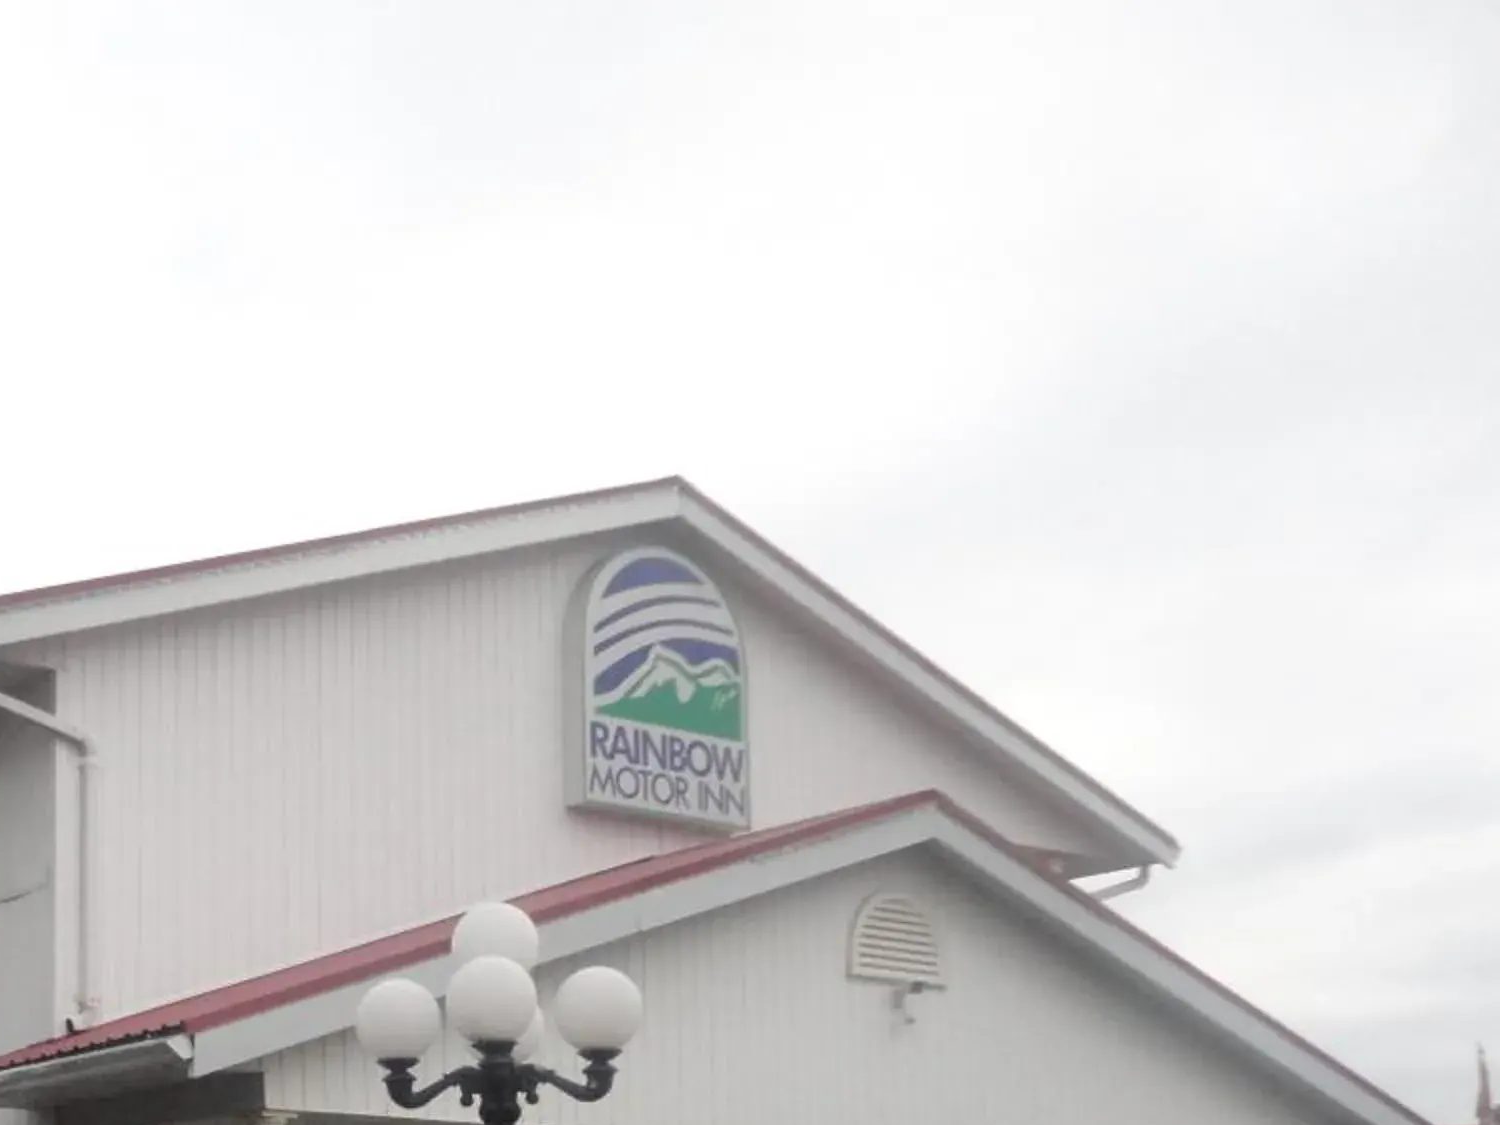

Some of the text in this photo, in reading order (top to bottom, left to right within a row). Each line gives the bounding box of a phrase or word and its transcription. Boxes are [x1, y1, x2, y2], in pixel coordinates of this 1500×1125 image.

[590, 721, 744, 782] RAINBOW
[589, 765, 746, 816] MOTOR INN
